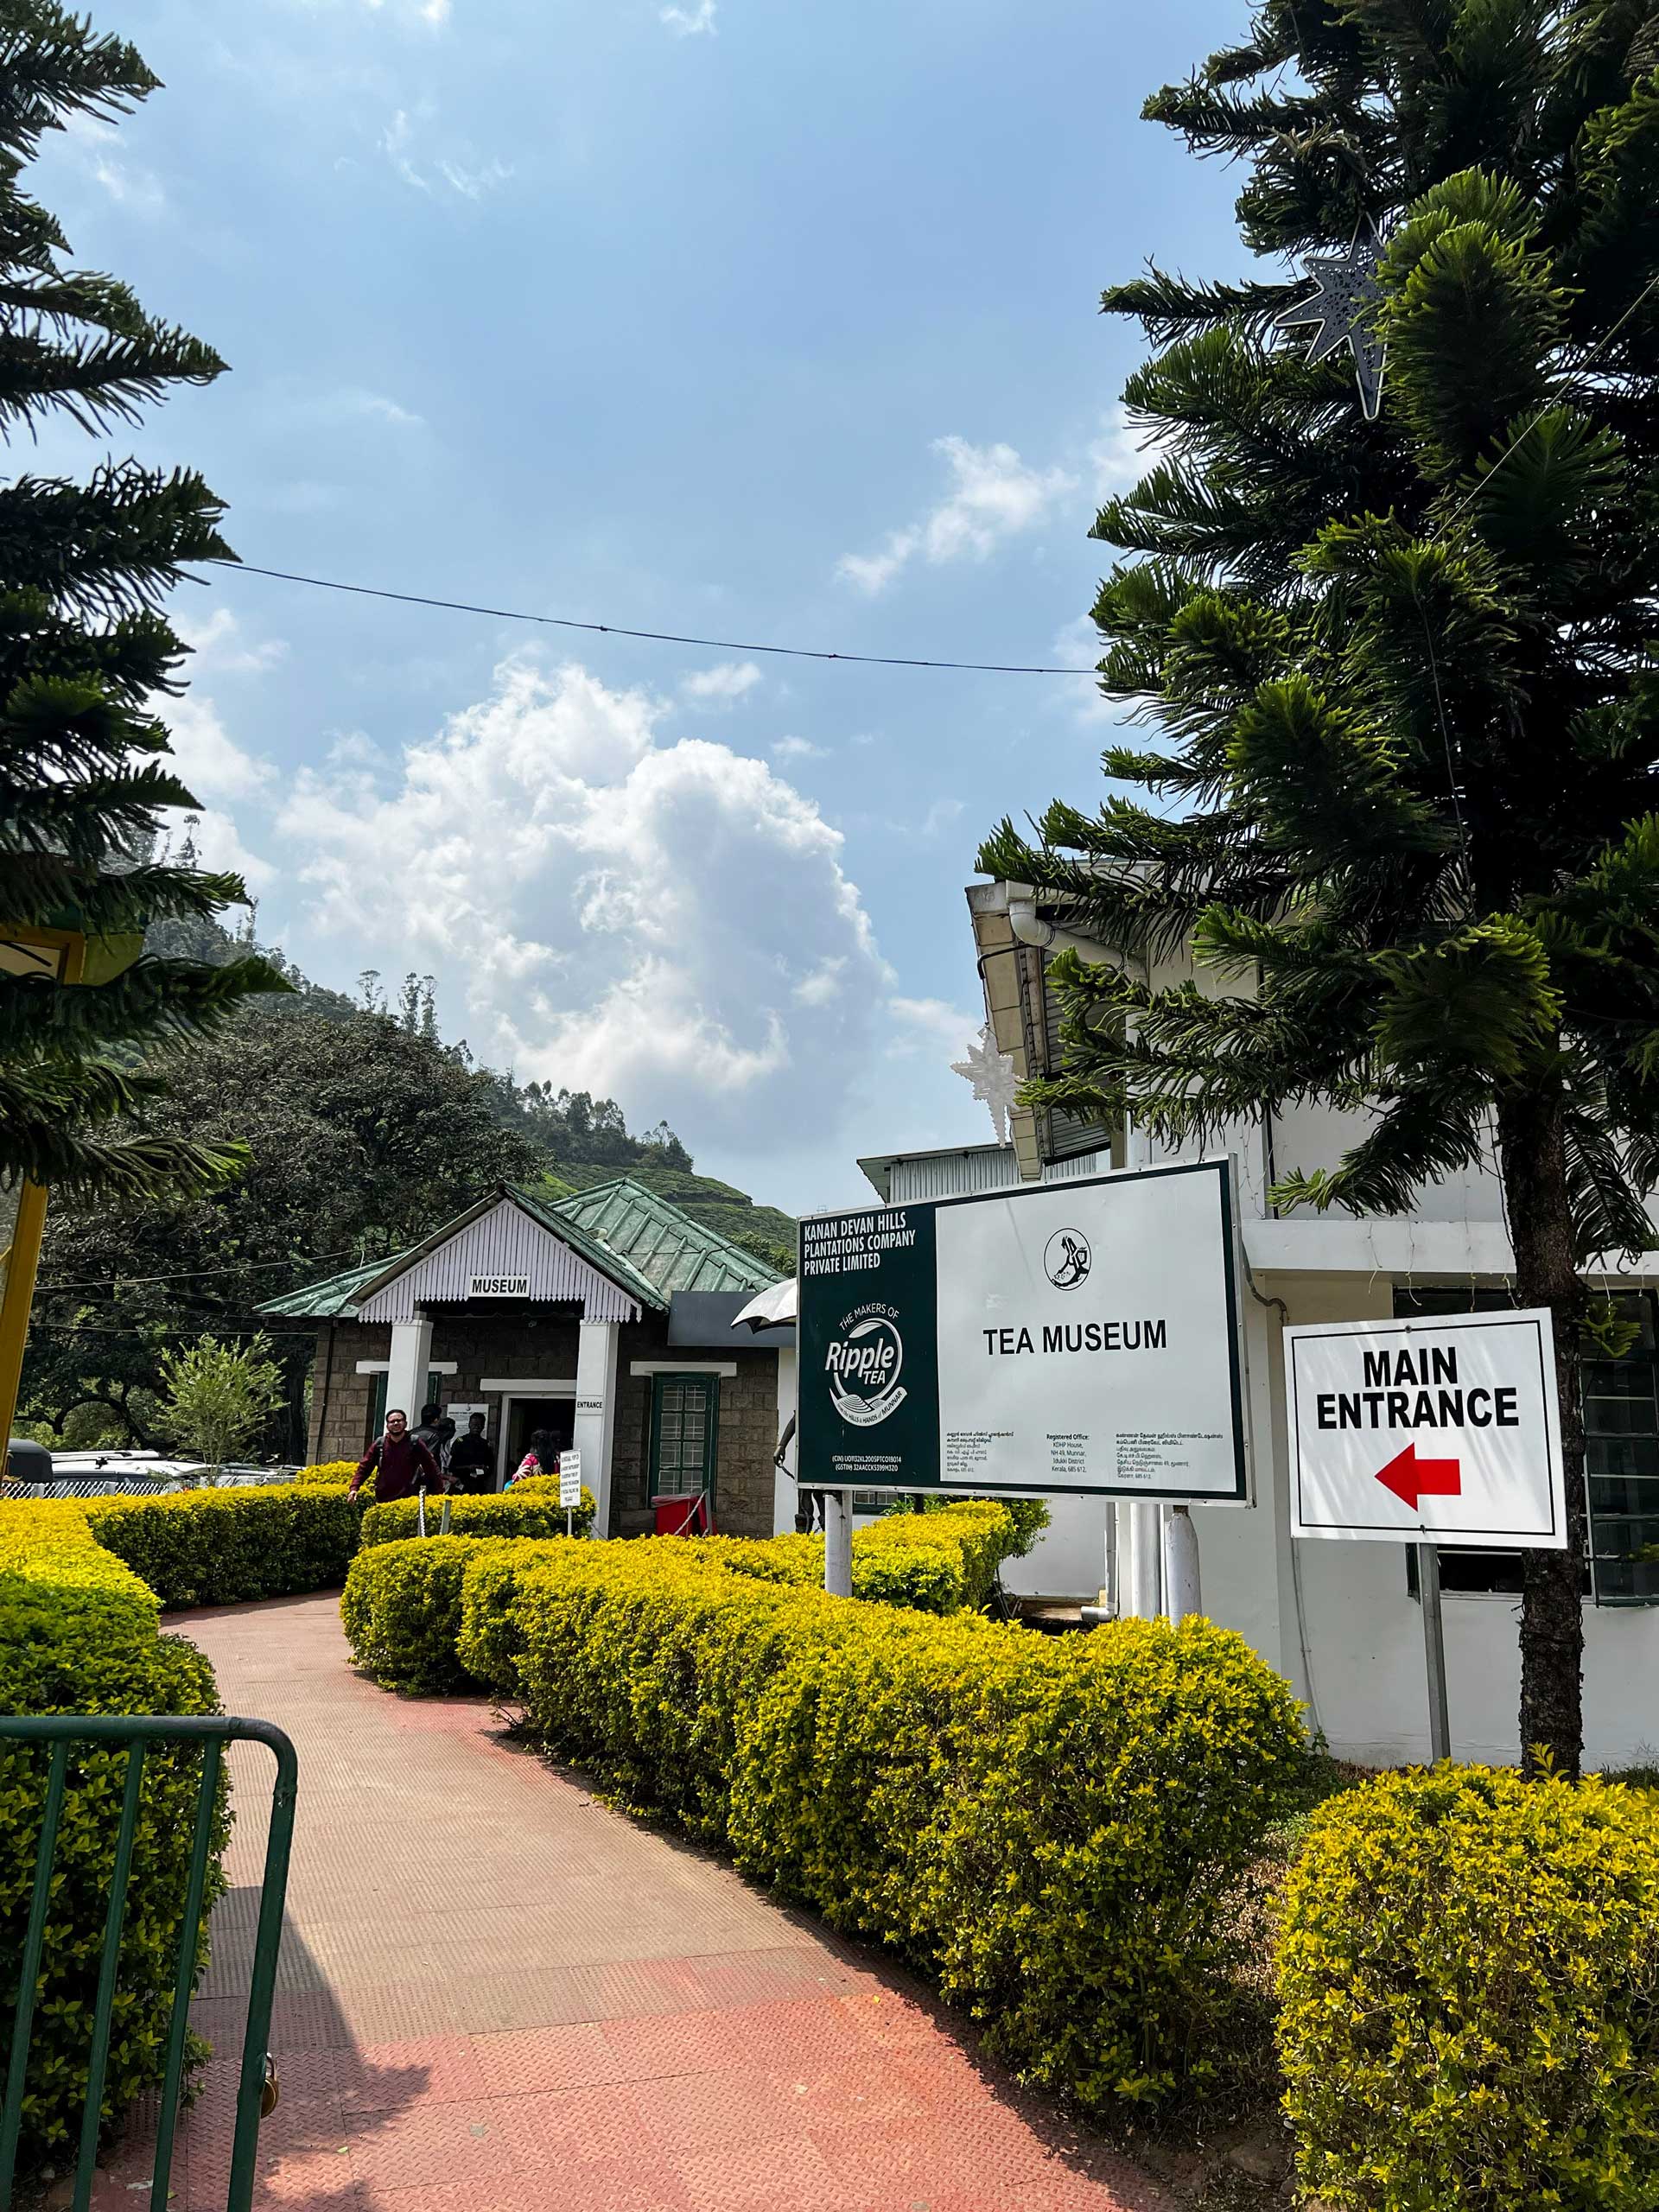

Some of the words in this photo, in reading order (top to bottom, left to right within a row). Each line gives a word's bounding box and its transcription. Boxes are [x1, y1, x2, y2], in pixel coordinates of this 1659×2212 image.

[804, 1222, 837, 1242] KANAN
[841, 1217, 874, 1236] DEVAN
[878, 1211, 906, 1231] HILLS
[804, 1236, 865, 1259] PLANTATIONS
[868, 1230, 916, 1250] COMPANY
[804, 1257, 840, 1276] PRIVATE
[842, 1252, 880, 1272] LIMITED
[472, 1279, 527, 1294] MUSEUM
[839, 1313, 855, 1331] THE
[854, 1302, 887, 1319] MAKERS
[887, 1306, 899, 1319] OF
[983, 1327, 1035, 1355] TEA
[1043, 1319, 1167, 1353] MUSEUM
[825, 1338, 894, 1378] Ripple
[1363, 1346, 1458, 1388] MAIN
[864, 1370, 886, 1384] TEA
[849, 1414, 860, 1424] HILLS
[863, 1414, 878, 1424] HANDS
[881, 1390, 903, 1416] MUNNAR
[1317, 1387, 1519, 1429] ENTRANCE
